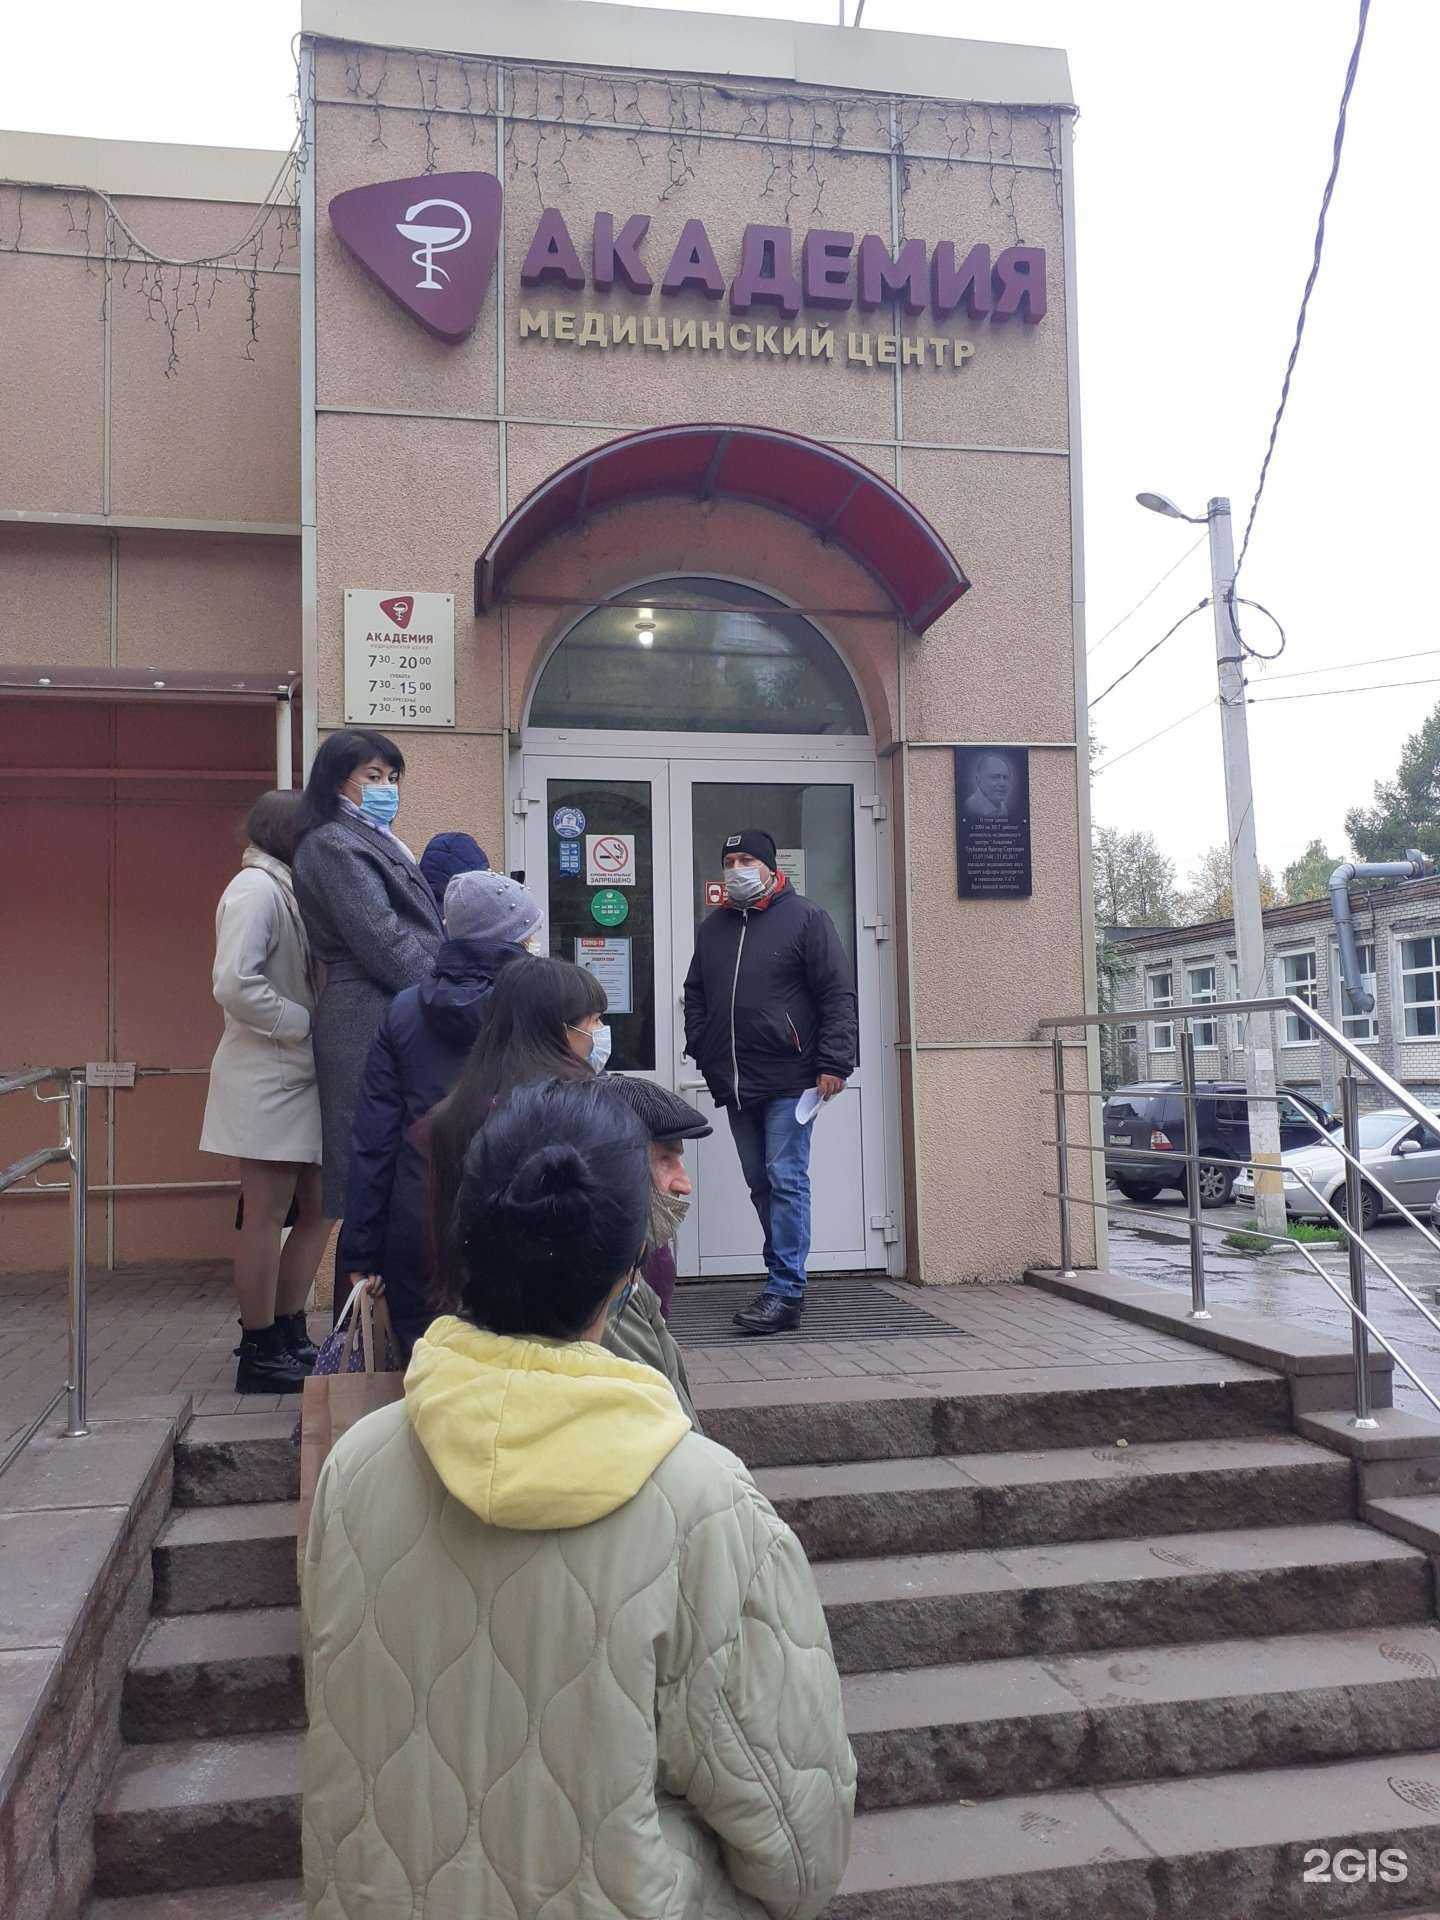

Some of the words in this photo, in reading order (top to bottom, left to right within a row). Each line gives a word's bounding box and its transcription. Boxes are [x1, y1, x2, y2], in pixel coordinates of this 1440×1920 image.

[520, 207, 1047, 325] АКАДЕМИЯ
[519, 307, 835, 359] МЕДИЦИНСКИЙ
[846, 330, 976, 368] ЦЕНТР
[366, 632, 434, 644] АКАДЕМИЯ
